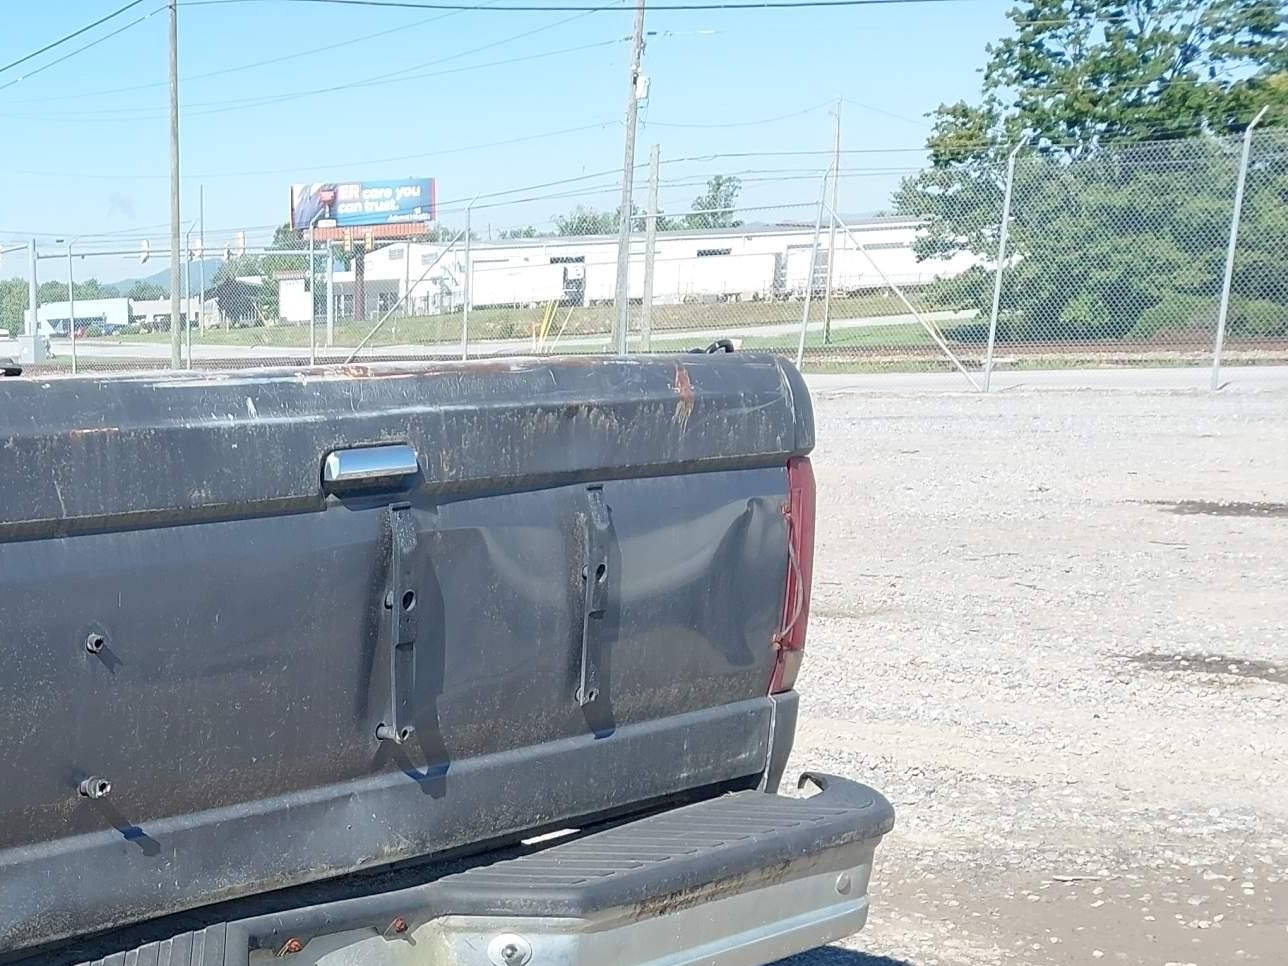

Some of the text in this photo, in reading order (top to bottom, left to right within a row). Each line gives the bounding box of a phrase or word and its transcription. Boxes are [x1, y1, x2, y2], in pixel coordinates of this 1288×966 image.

[363, 188, 393, 199] care
[396, 186, 421, 200] you
[338, 202, 362, 213] can
